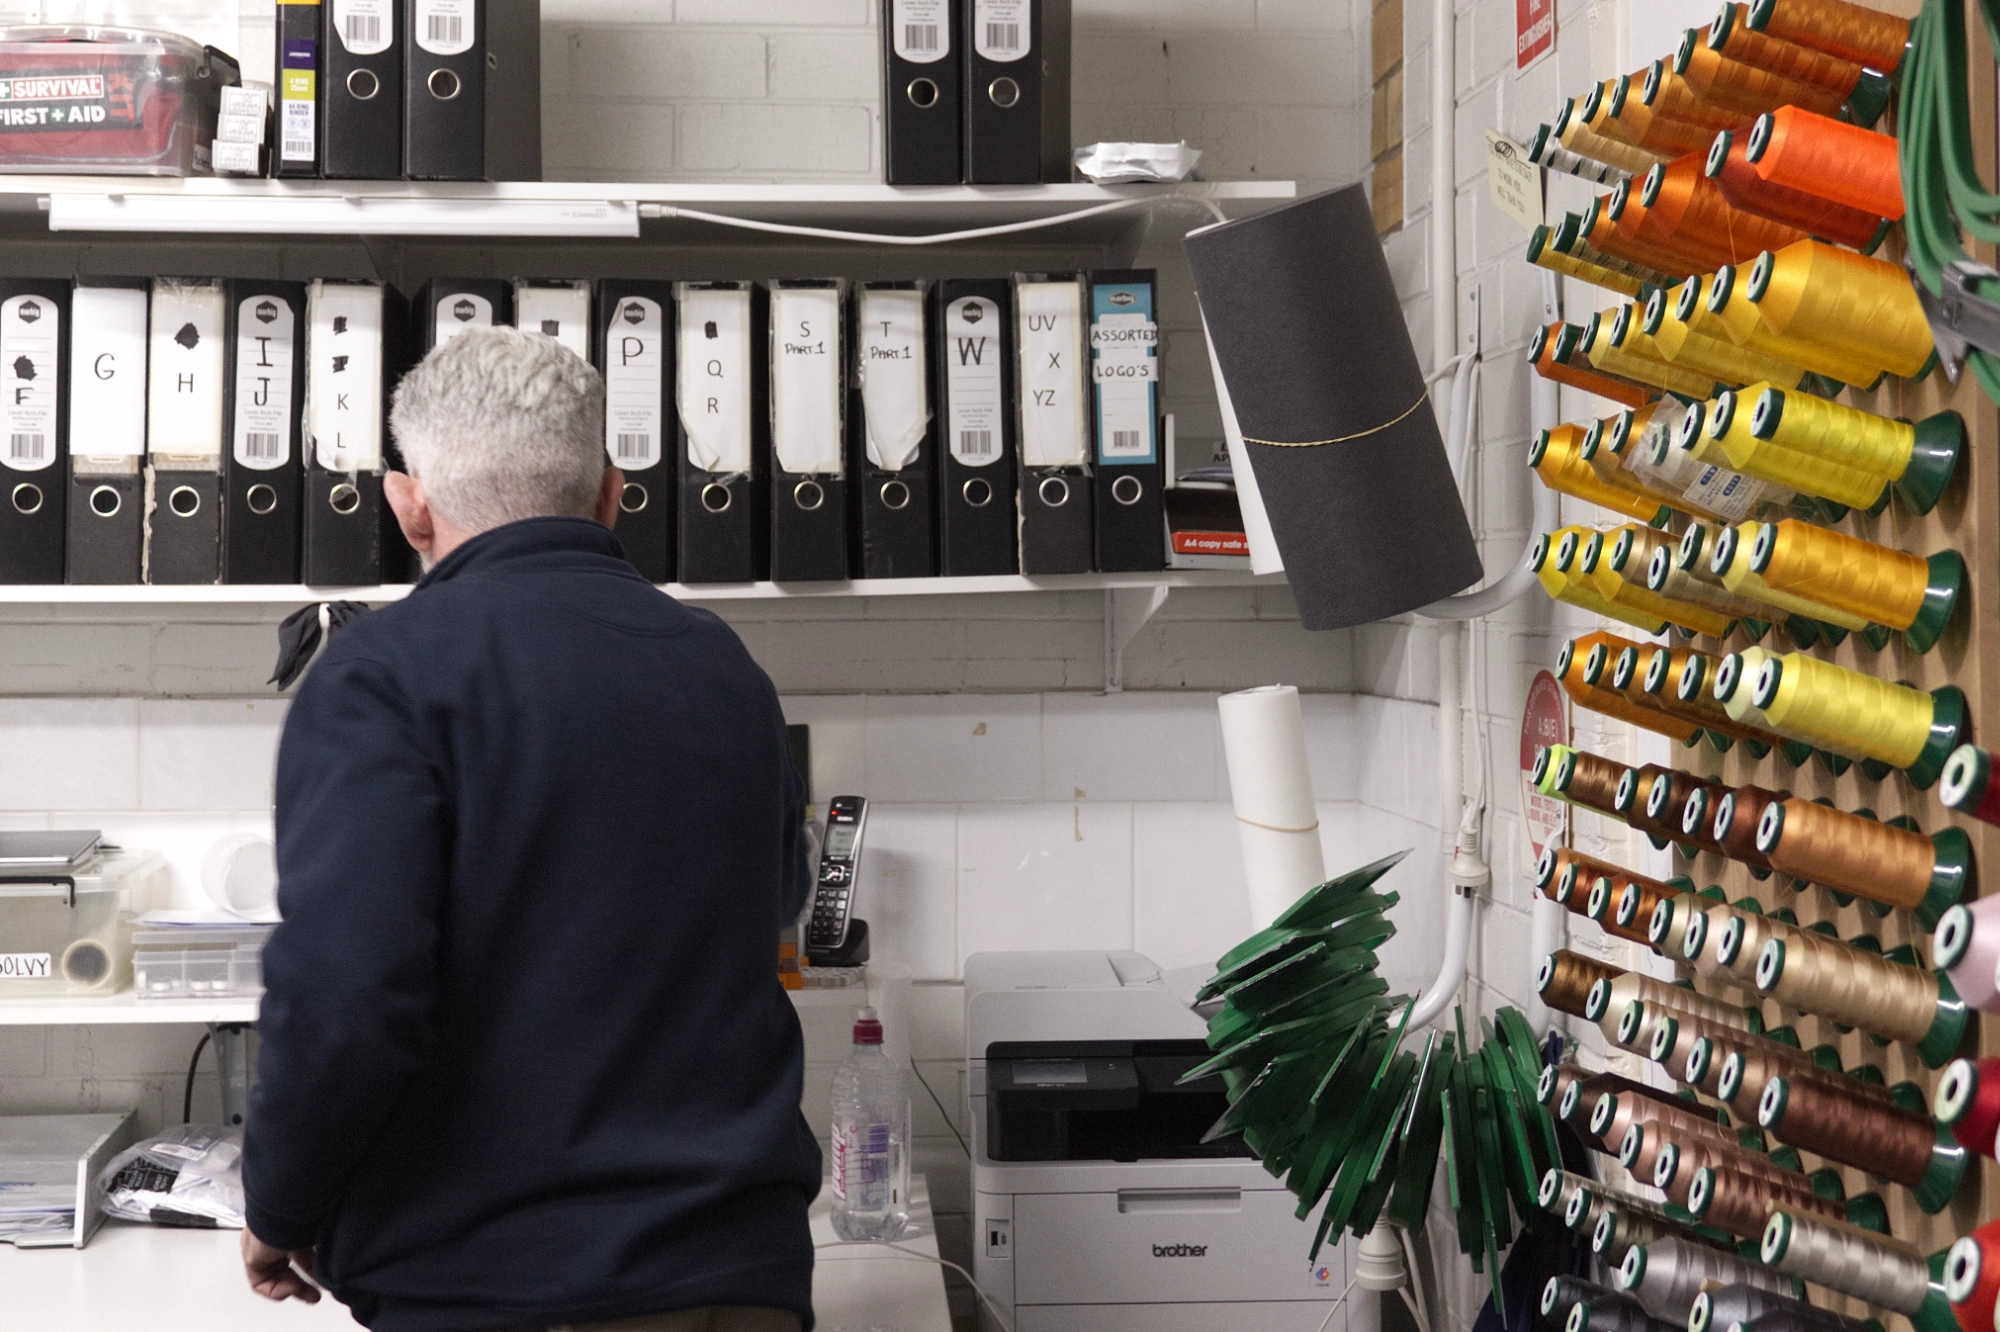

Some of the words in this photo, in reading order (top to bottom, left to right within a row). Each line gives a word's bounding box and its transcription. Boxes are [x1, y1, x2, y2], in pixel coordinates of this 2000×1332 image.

[14, 79, 100, 97] SURVIVAL
[107, 73, 135, 122] KIT
[68, 105, 106, 123] AID
[19, 307, 40, 318] marbig
[256, 307, 277, 318] marbig
[454, 305, 475, 316] marbig
[624, 308, 645, 319] marbig
[963, 307, 982, 318] marbig
[800, 321, 811, 338] S
[880, 321, 892, 337] T
[1028, 314, 1057, 332] UV
[1092, 329, 1157, 342] ASSORTED
[254, 336, 274, 367] I
[621, 336, 644, 367] P
[957, 337, 986, 366] W
[93, 352, 116, 381] G
[707, 360, 724, 378] Q
[1048, 353, 1061, 369] X
[1096, 365, 1149, 378] LOGO'S
[177, 372, 195, 394] H
[15, 387, 34, 405] F
[254, 377, 271, 407] J
[1032, 389, 1056, 406] YZ
[337, 393, 349, 411] K
[707, 397, 719, 414] R
[336, 431, 346, 449] L
[1184, 539, 1197, 547] A4
[1198, 540, 1220, 549] copy
[1223, 540, 1242, 549] safe
[1152, 1243, 1208, 1258] brother
